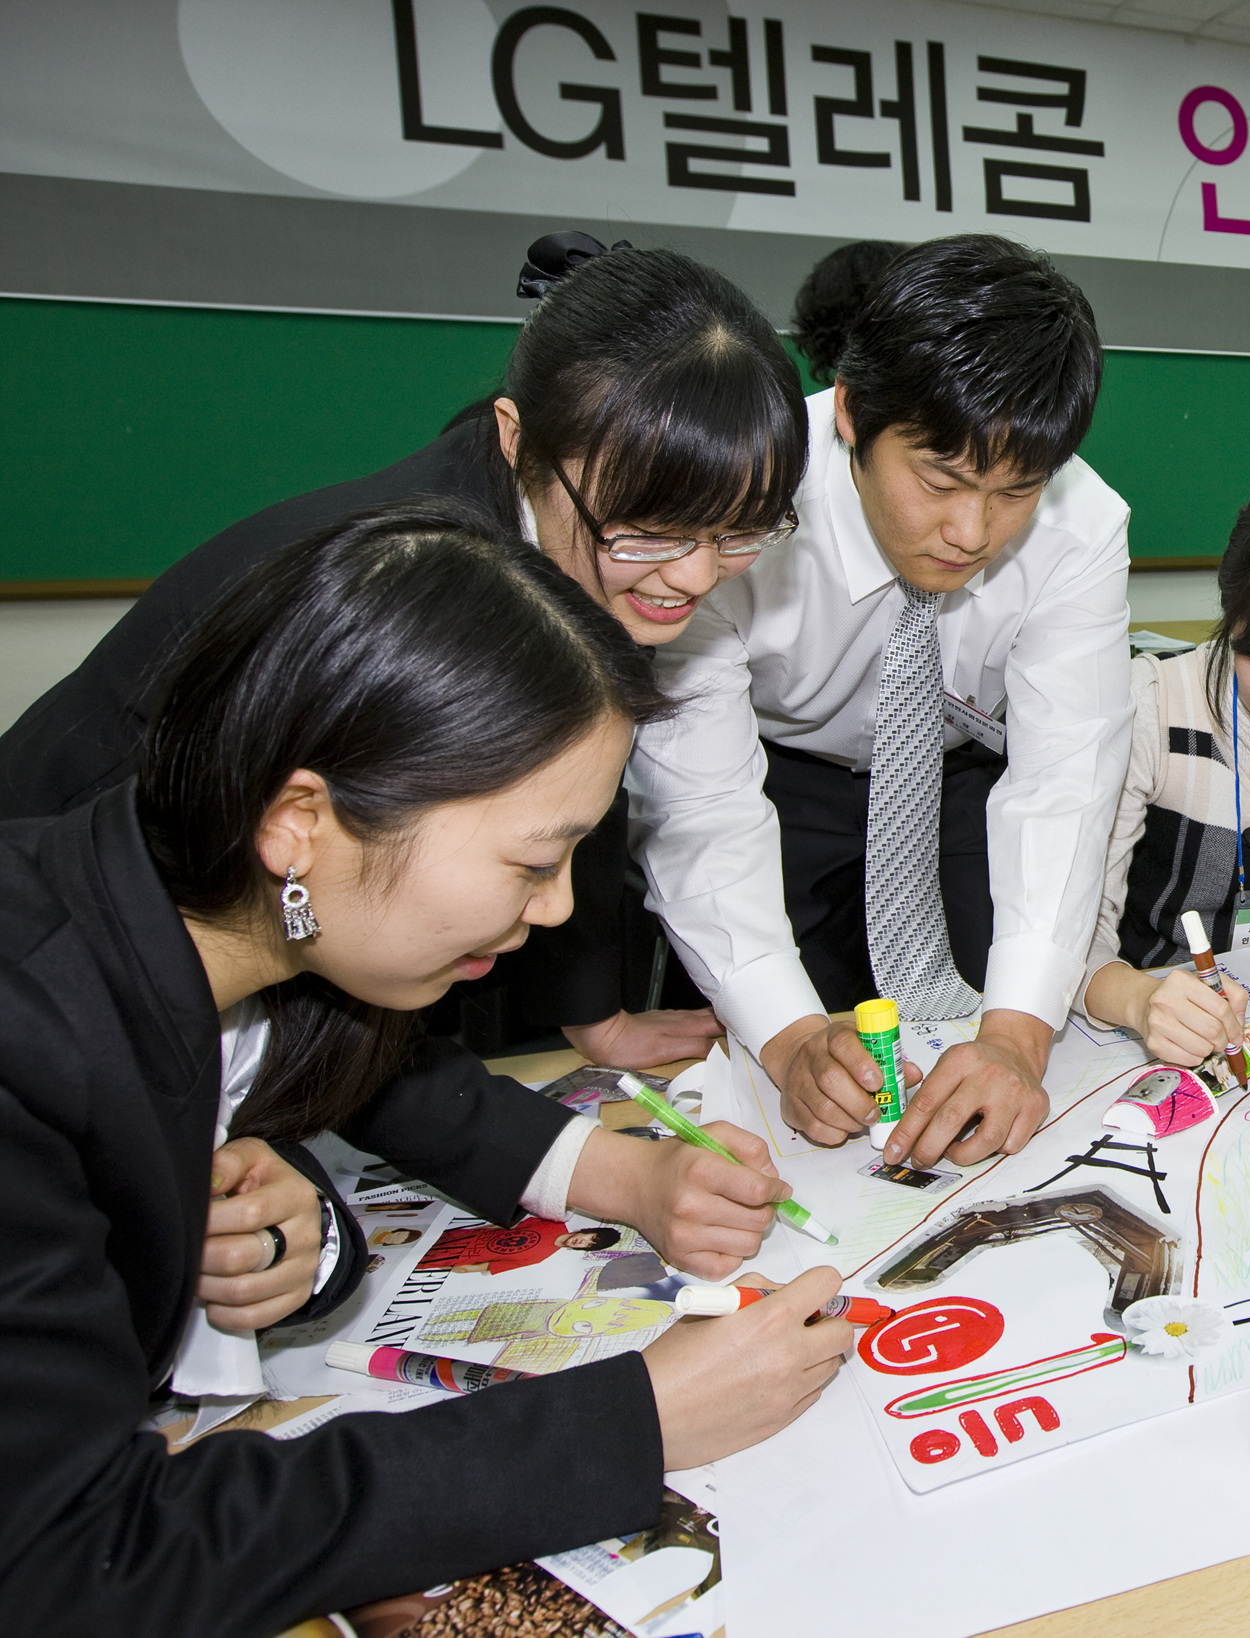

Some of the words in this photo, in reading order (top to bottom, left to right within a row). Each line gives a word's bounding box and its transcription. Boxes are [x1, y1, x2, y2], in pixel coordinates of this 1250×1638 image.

[391, 0, 1106, 222] LG텔레콤
[358, 1189, 400, 1202] FASHION
[400, 1183, 429, 1193] PICKS
